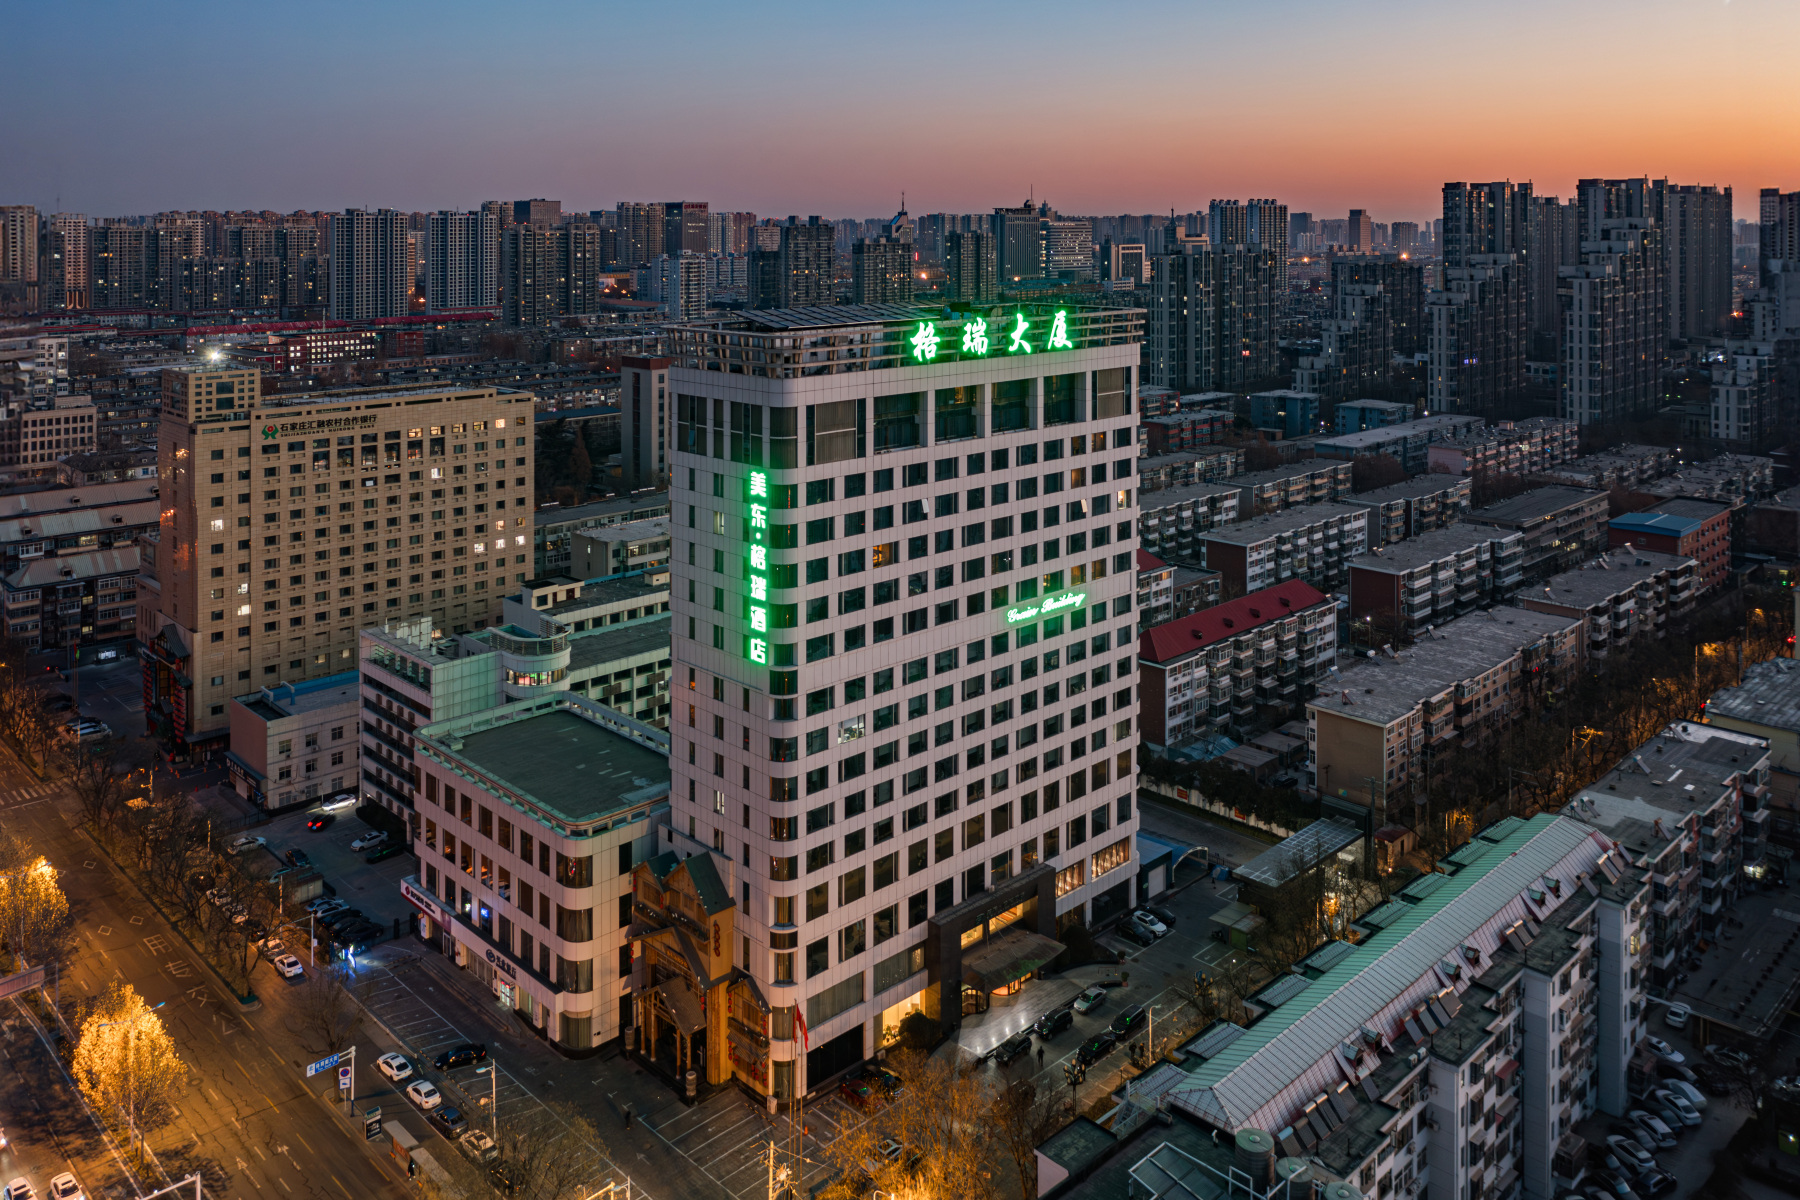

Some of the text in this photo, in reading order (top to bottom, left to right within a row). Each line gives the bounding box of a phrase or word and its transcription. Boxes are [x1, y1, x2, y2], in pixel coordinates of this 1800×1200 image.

[910, 310, 1073, 361] 格瑞大厦
[280, 415, 377, 432] 石家庄汇融农村合作银行
[1041, 592, 1086, 614] Building
